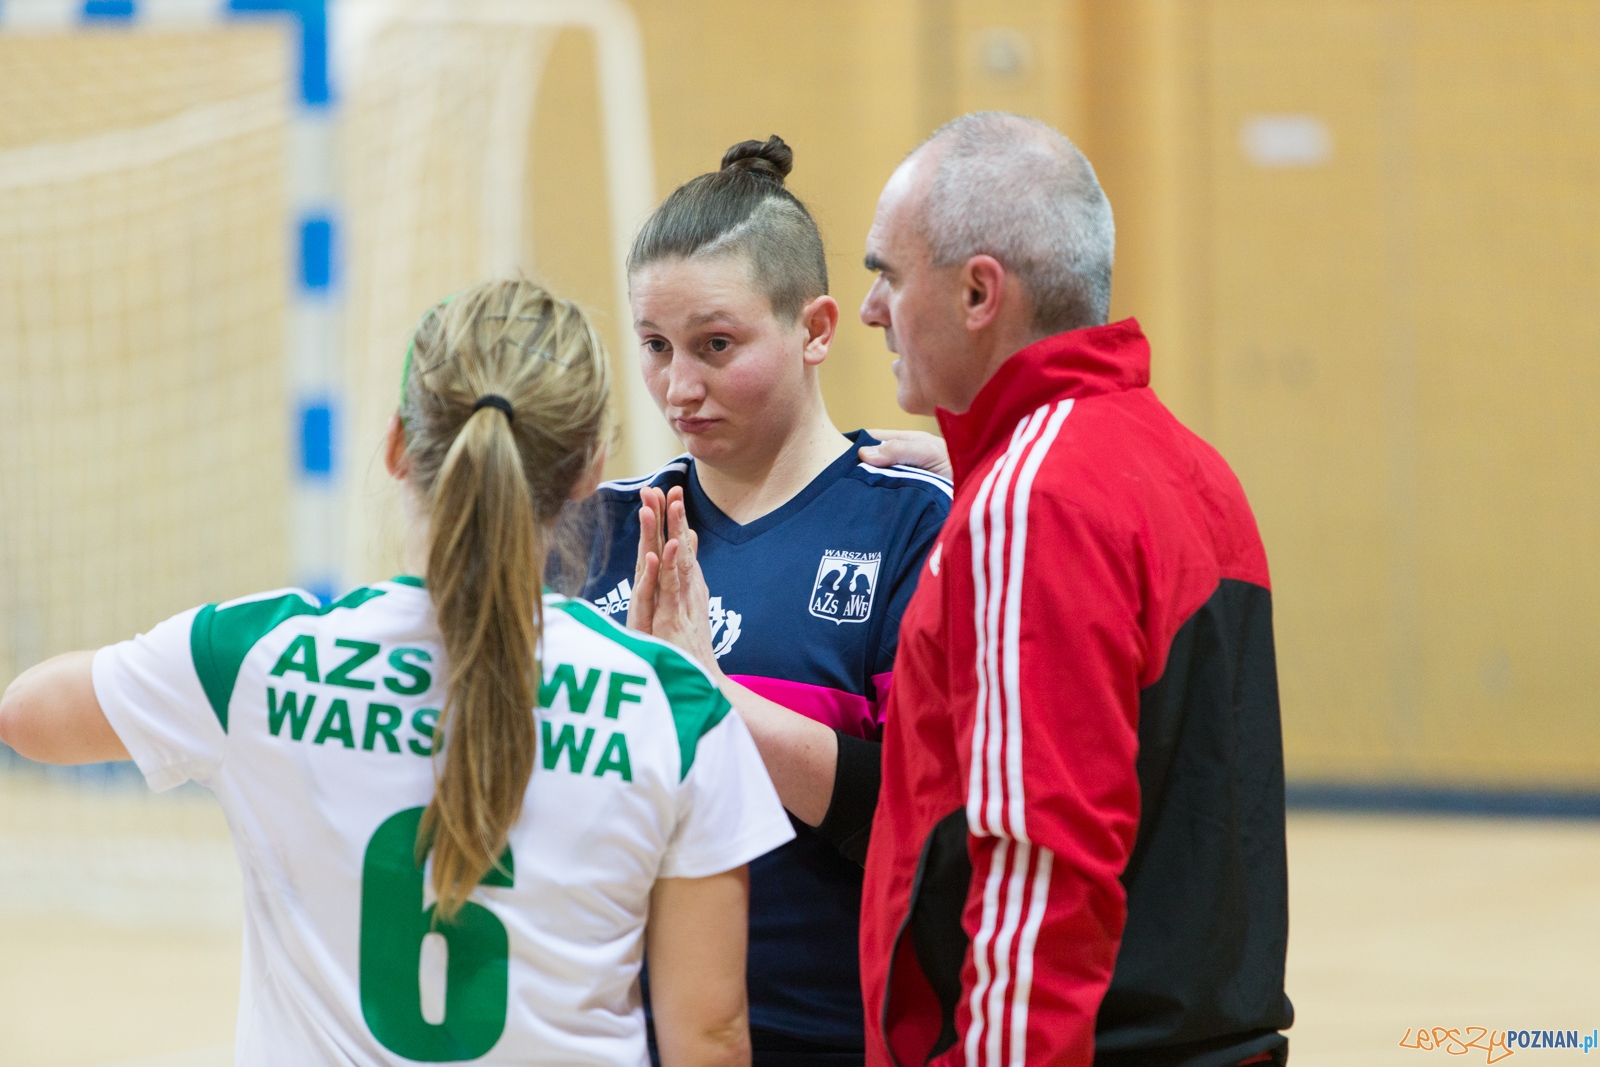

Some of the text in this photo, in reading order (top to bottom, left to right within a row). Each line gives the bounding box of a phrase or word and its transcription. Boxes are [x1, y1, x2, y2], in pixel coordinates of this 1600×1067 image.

[824, 549, 882, 561] WARSZAWA
[812, 592, 869, 617] AZS AWF
[269, 634, 647, 720] AZS WF
[266, 687, 633, 783] WARSWA
[359, 805, 515, 1063] 6
